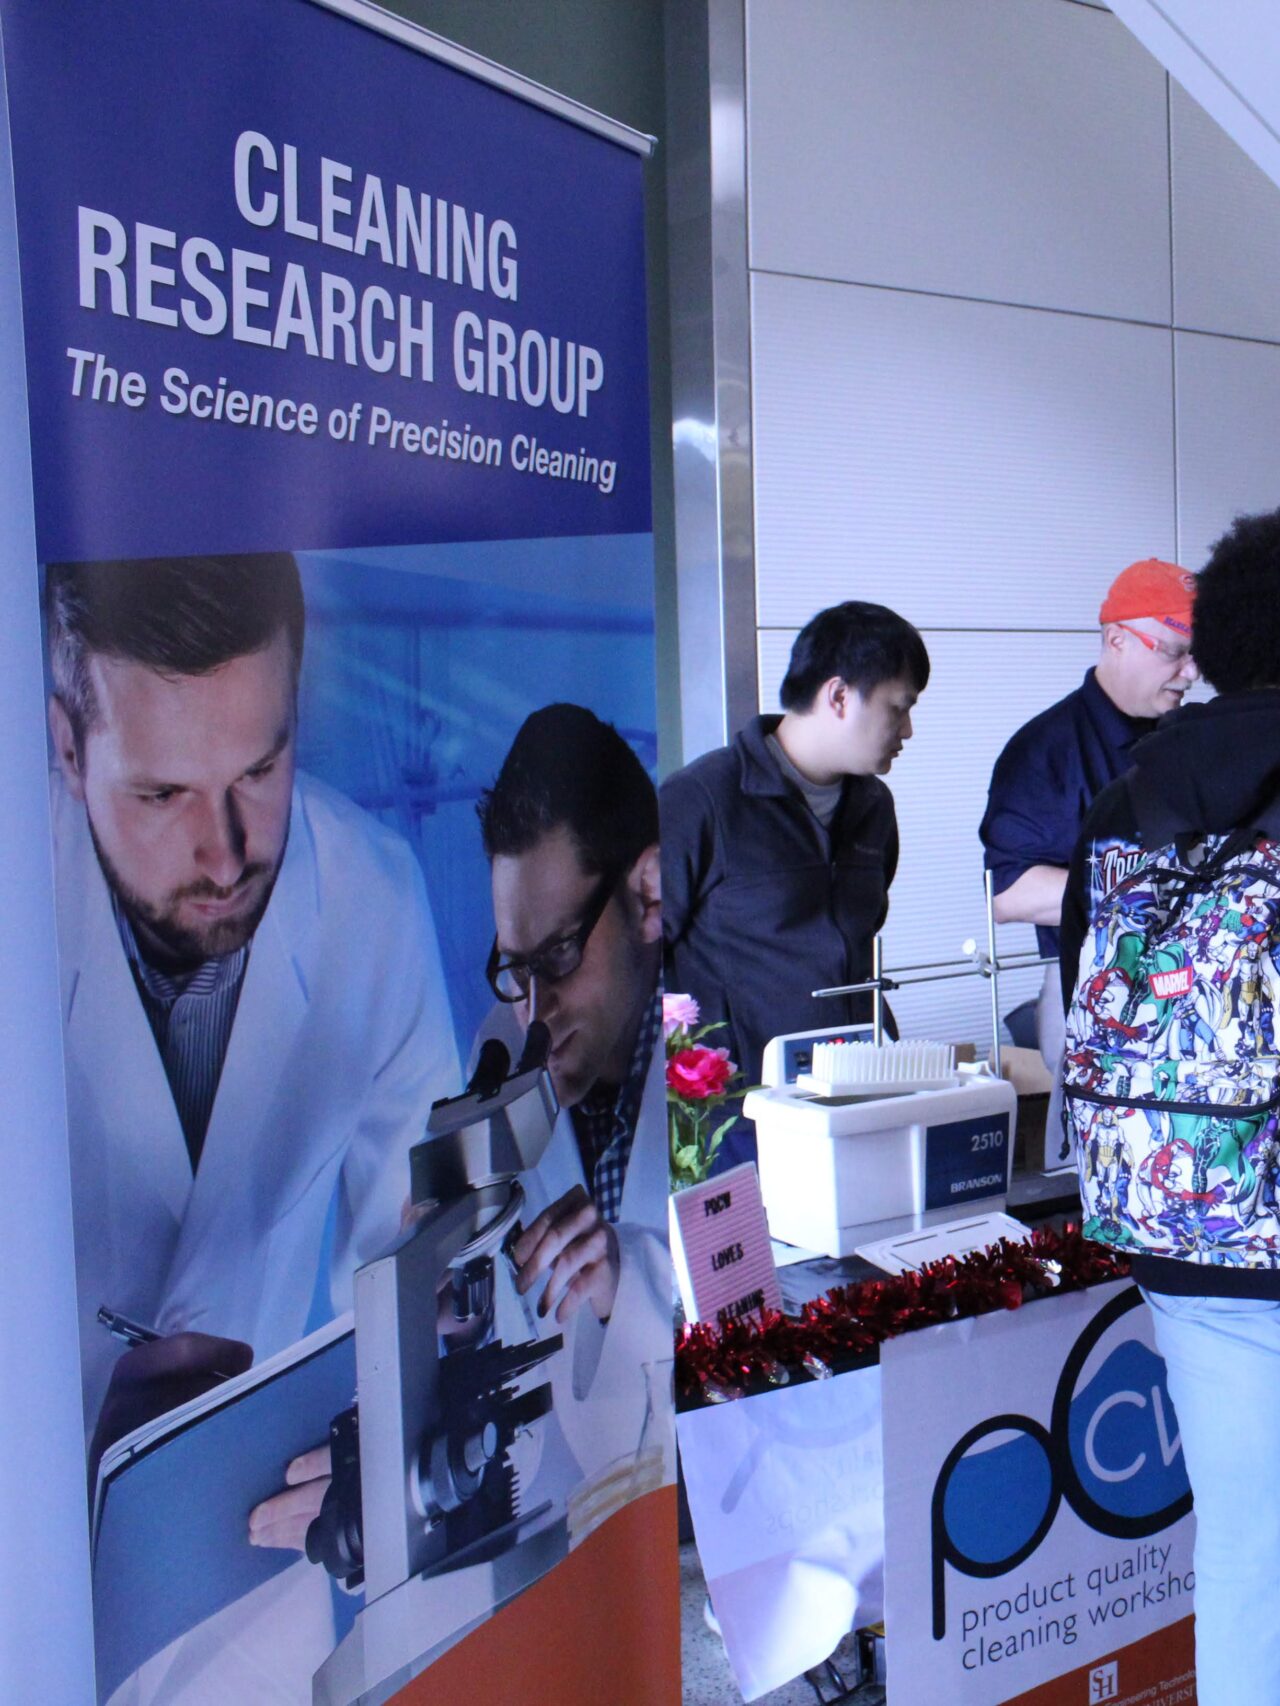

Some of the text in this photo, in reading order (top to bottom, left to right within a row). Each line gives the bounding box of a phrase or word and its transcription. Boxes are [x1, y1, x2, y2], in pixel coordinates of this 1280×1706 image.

[233, 130, 518, 301] CLEANING
[78, 205, 604, 418] RESEARCH GROUP
[66, 348, 617, 493] The Science of Precision Cleaning
[1153, 970, 1189, 996] MARVEL
[971, 1130, 1004, 1152] 2510
[704, 1191, 731, 1217] PQCW
[950, 1174, 1002, 1193] BRANSON
[711, 1242, 744, 1272] LOVES
[961, 1543, 1172, 1642] product quality
[961, 1613, 1078, 1670] cleaning
